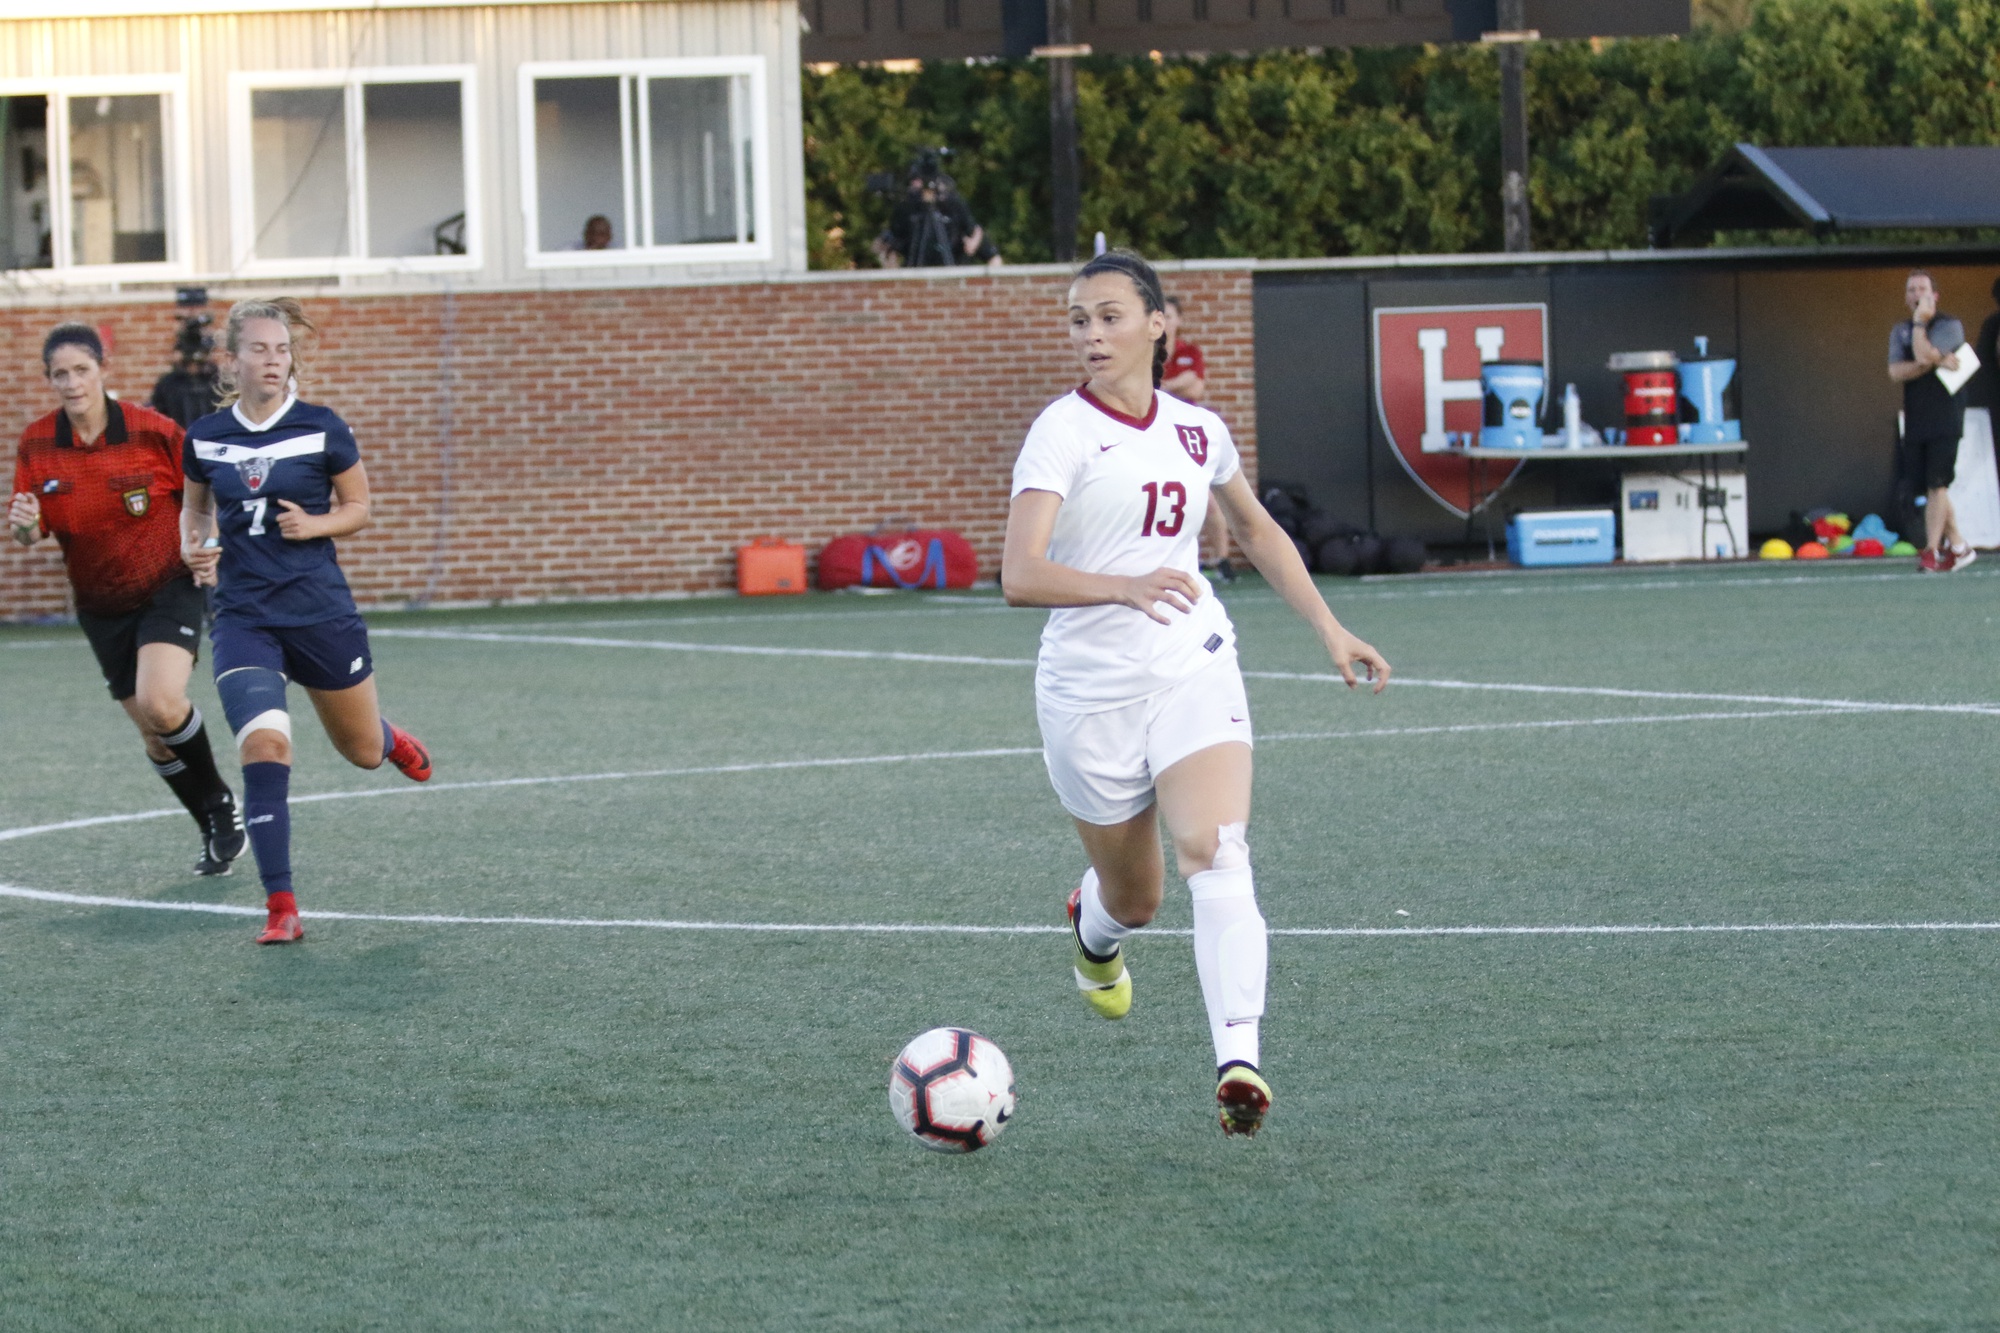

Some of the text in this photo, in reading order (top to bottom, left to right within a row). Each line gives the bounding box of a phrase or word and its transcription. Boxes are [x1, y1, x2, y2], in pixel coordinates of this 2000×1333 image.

[1417, 326, 1504, 452] H
[1182, 429, 1204, 455] H
[242, 497, 267, 536] 7
[1141, 481, 1187, 537] 13
